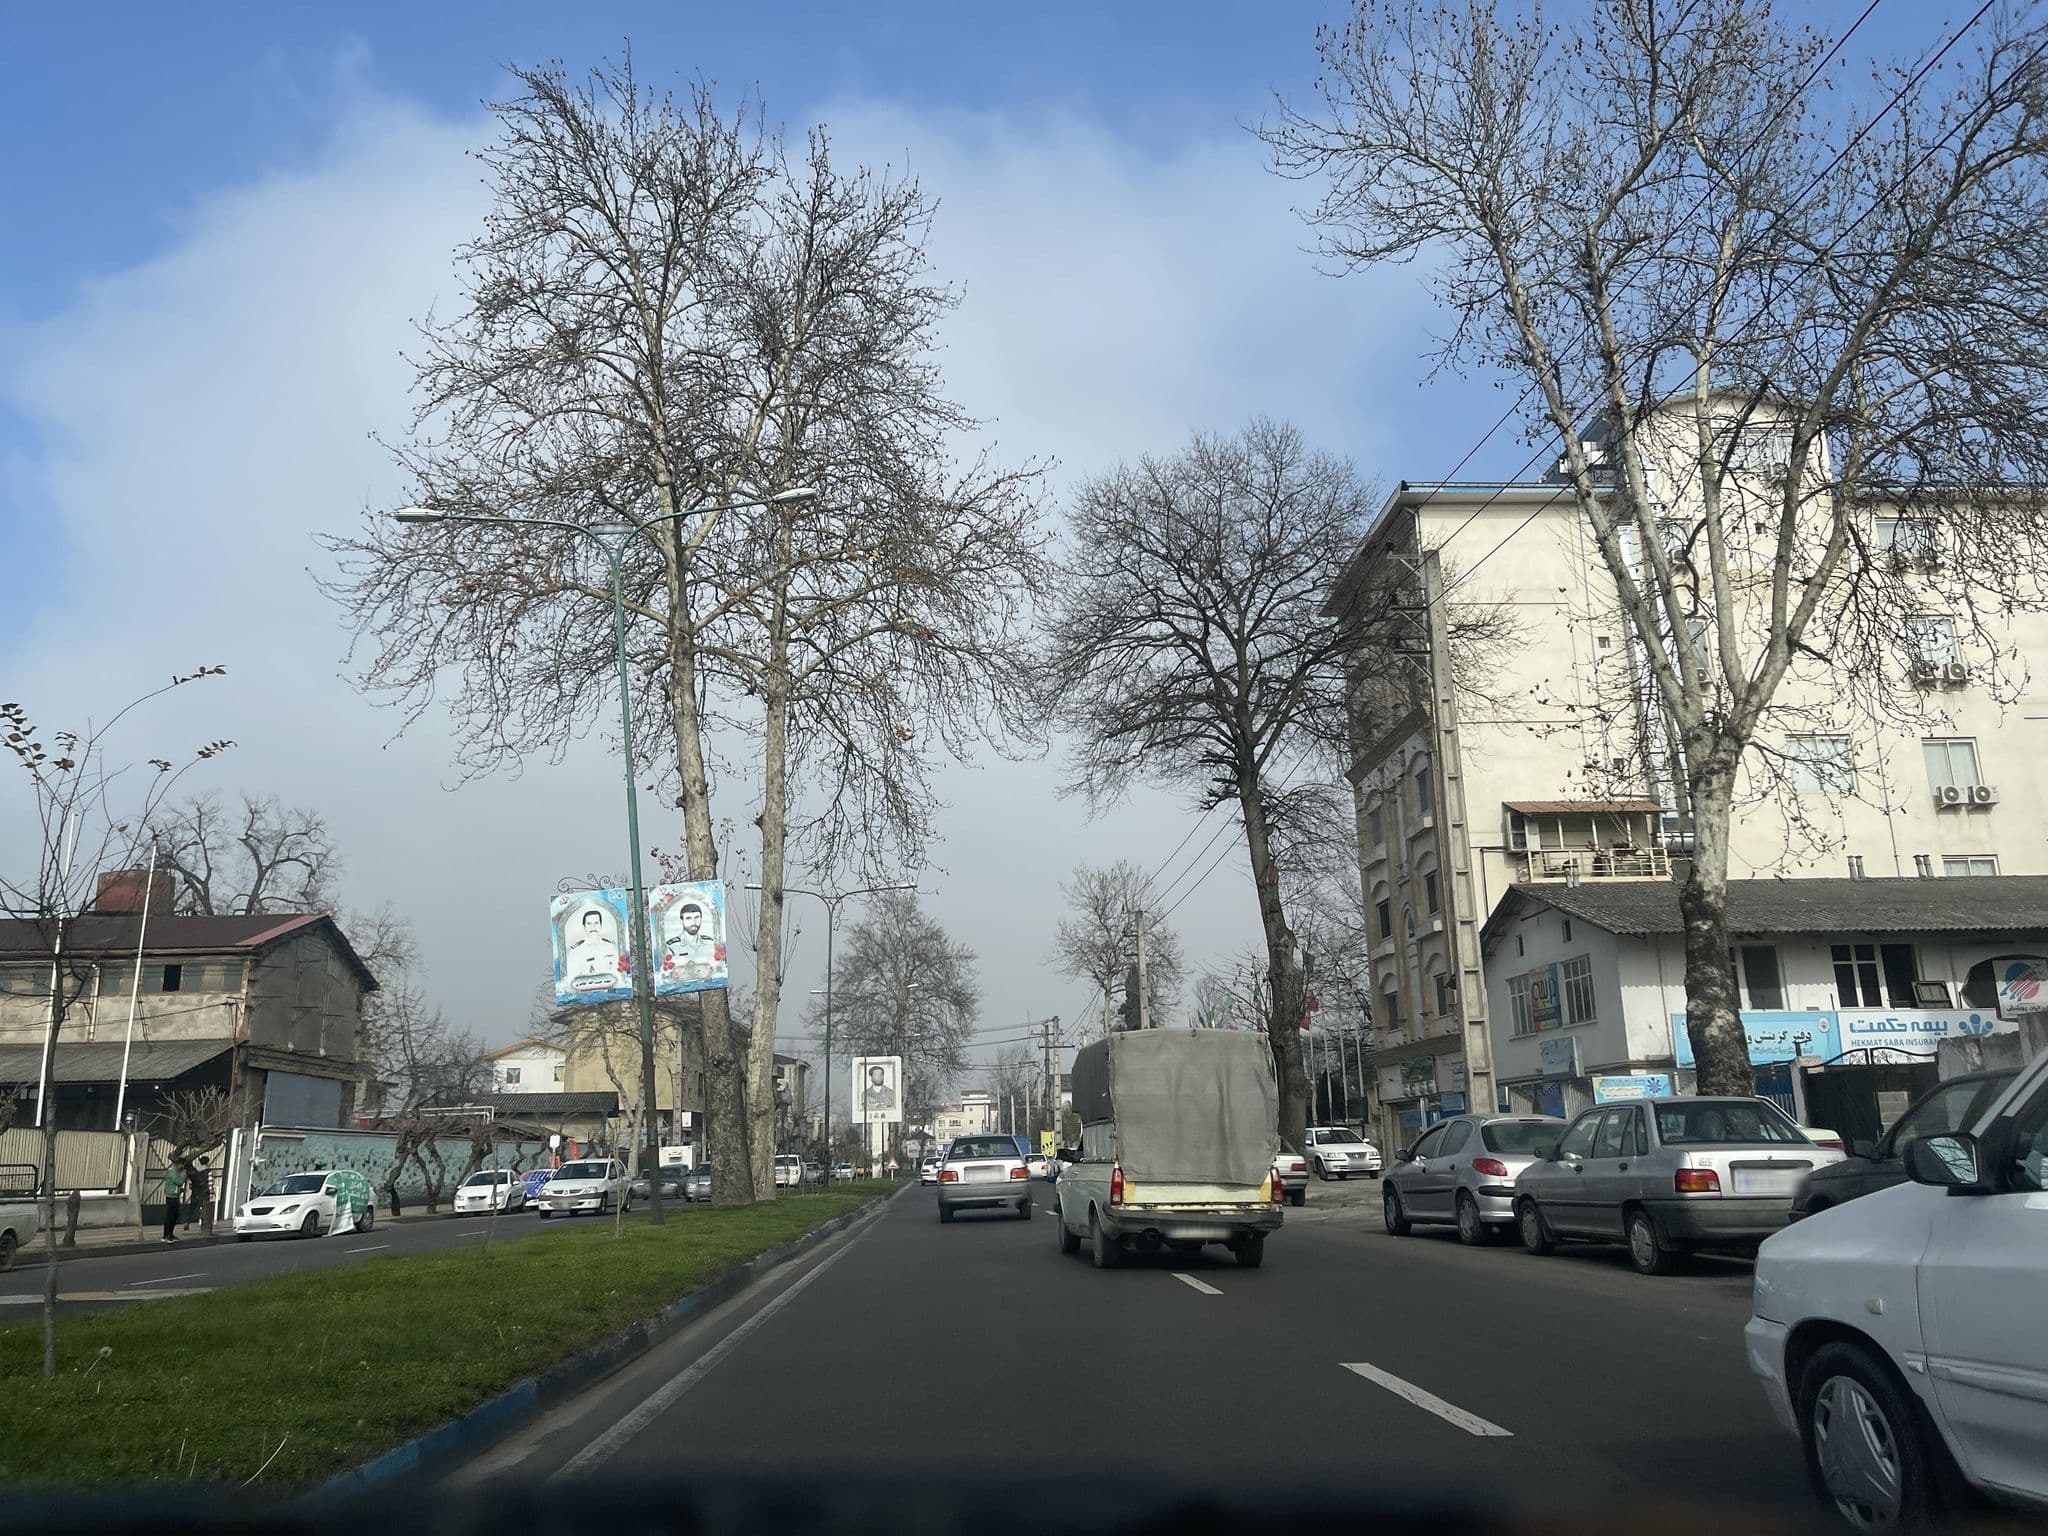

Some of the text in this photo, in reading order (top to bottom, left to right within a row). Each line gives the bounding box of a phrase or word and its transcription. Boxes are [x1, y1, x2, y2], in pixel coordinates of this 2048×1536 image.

[1849, 1018, 1948, 1035] بیمه حکمت
[1850, 1039, 1883, 1047] HEKMAT
[1906, 1038, 1937, 1046] INSURAN
